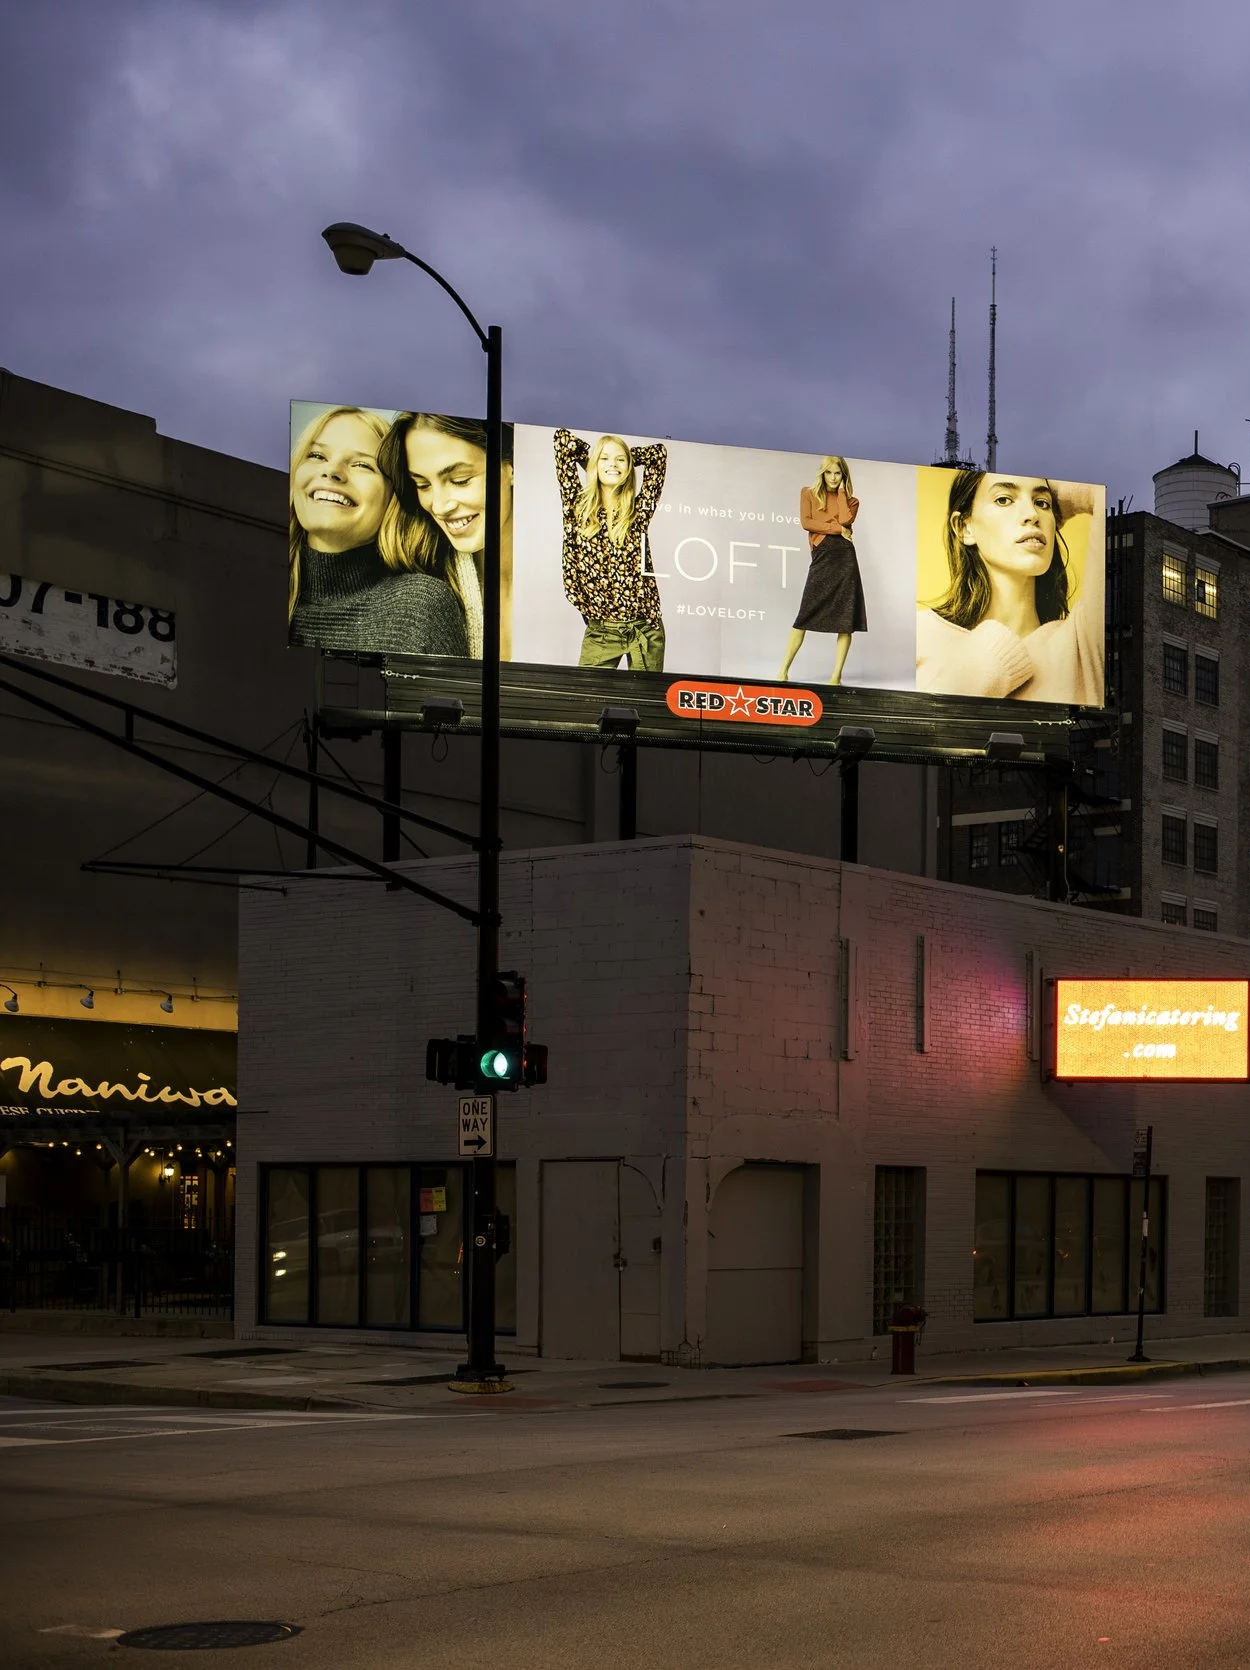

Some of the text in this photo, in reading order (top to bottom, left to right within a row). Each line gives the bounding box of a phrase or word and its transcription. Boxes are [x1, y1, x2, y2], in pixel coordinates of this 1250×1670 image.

[642, 501, 800, 525] Live in what you love
[641, 532, 800, 588] LOFT
[676, 603, 766, 621] #LOVELOFT
[678, 690, 815, 719] RED STAR
[1063, 1003, 1241, 1032] Stefanicatering
[1122, 1043, 1177, 1059] .com
[0, 1056, 238, 1107] Naniwa
[462, 1101, 488, 1116] ONE
[462, 1118, 489, 1132] WAY
